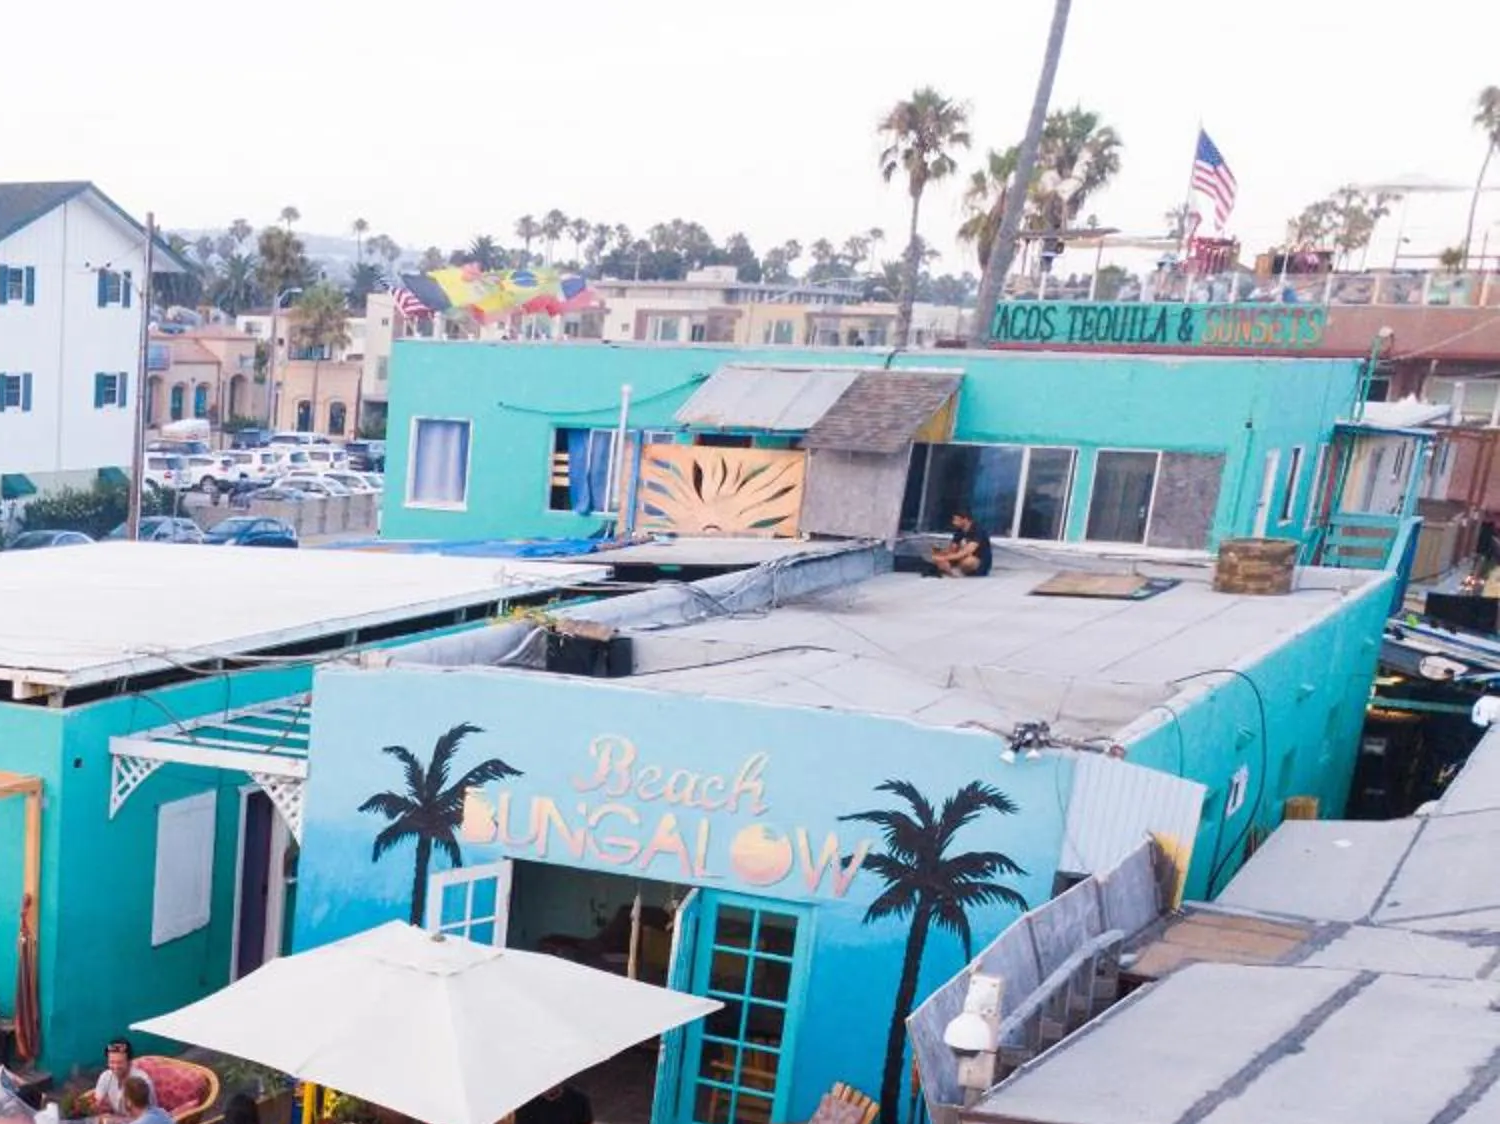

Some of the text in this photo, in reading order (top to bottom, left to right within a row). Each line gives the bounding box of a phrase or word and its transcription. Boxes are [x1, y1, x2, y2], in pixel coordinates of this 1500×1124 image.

[994, 304, 1324, 345] ACOS TEQUILA & SUNSETS
[572, 733, 769, 816] Beach
